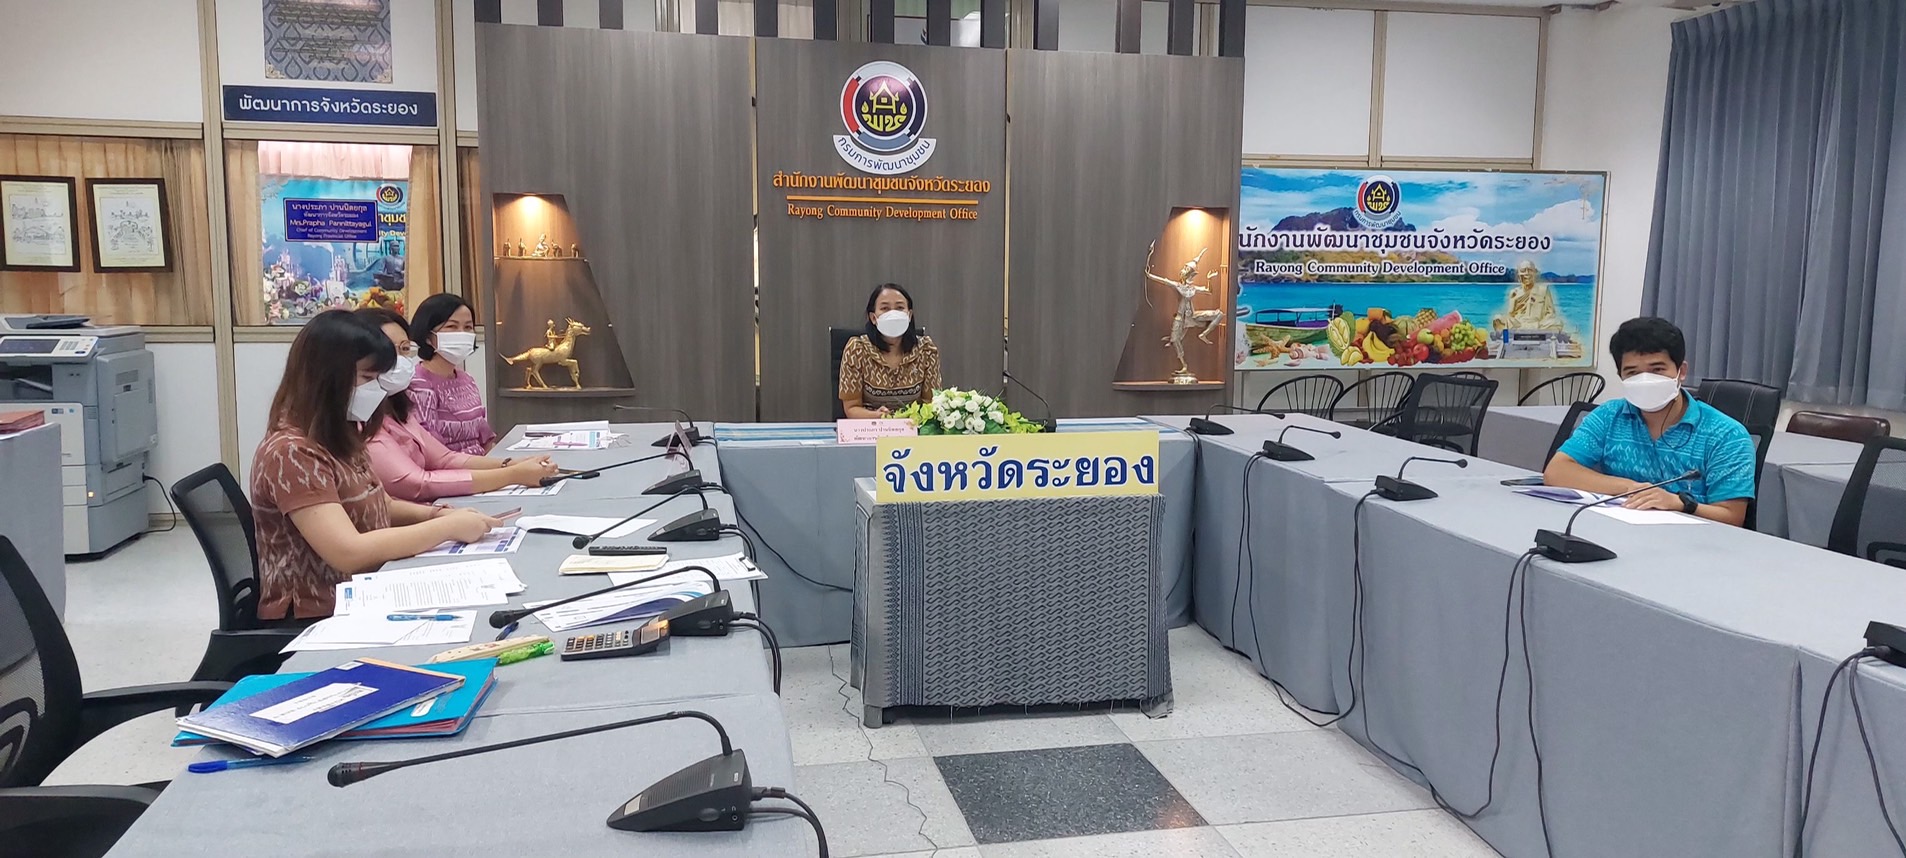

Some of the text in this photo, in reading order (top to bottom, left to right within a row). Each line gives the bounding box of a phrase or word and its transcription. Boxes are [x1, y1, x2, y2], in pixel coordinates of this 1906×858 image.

[239, 94, 418, 115] พัฒนาการจังหวัดระยอง
[837, 136, 931, 171] กรมการพัฒนาชุมชน
[773, 171, 991, 195] สำนักงานพัฒนาชุมชนจังหวัดระยอง
[787, 203, 978, 223] Rayong Community Development Office
[1255, 261, 1505, 276] Rayong Community Development Office
[882, 445, 1156, 493] จังหวัดระยอง
